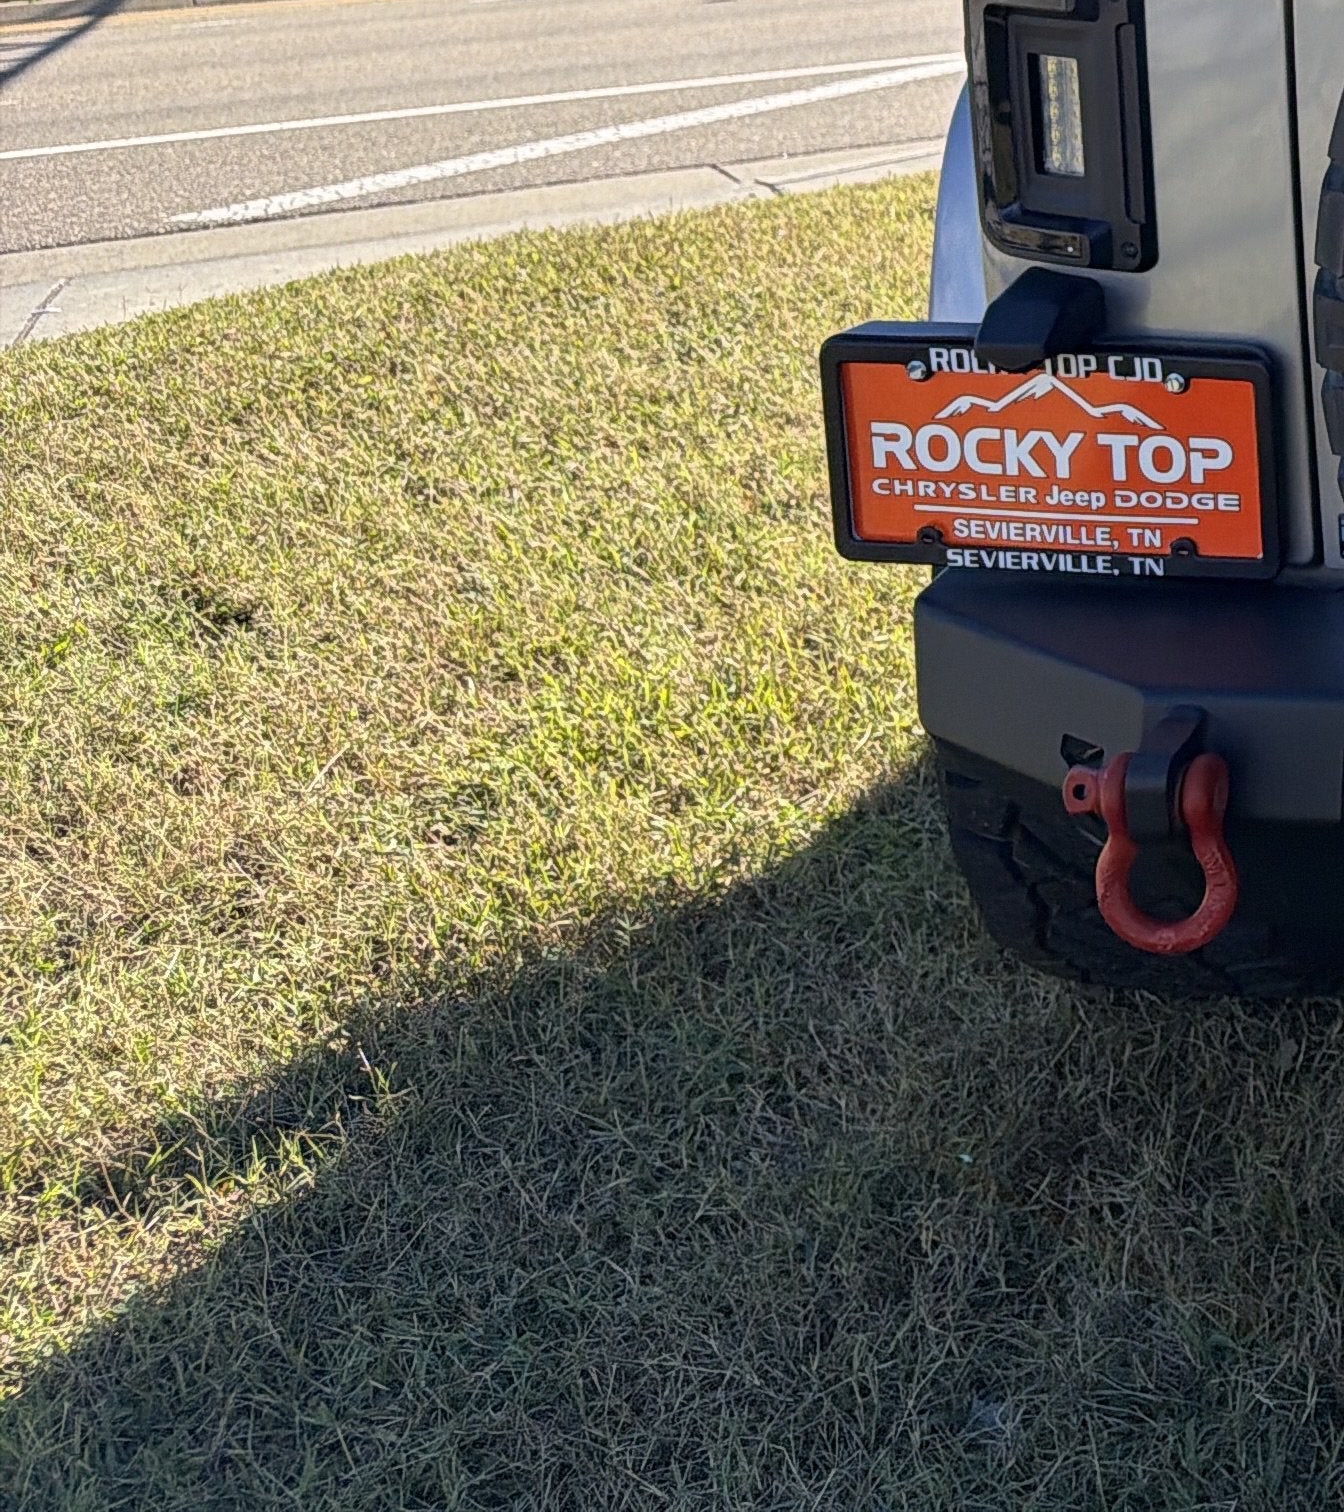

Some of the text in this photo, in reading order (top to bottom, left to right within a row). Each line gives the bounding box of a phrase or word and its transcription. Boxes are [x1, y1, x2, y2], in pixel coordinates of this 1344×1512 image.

[1108, 355, 1163, 383] CJD
[870, 421, 1234, 485] ROCKY TOP
[872, 478, 1240, 512] CHRYSLER Jeep DODGE
[953, 518, 1162, 550] SEVIERVILLE, TN
[1128, 557, 1165, 577] TN
